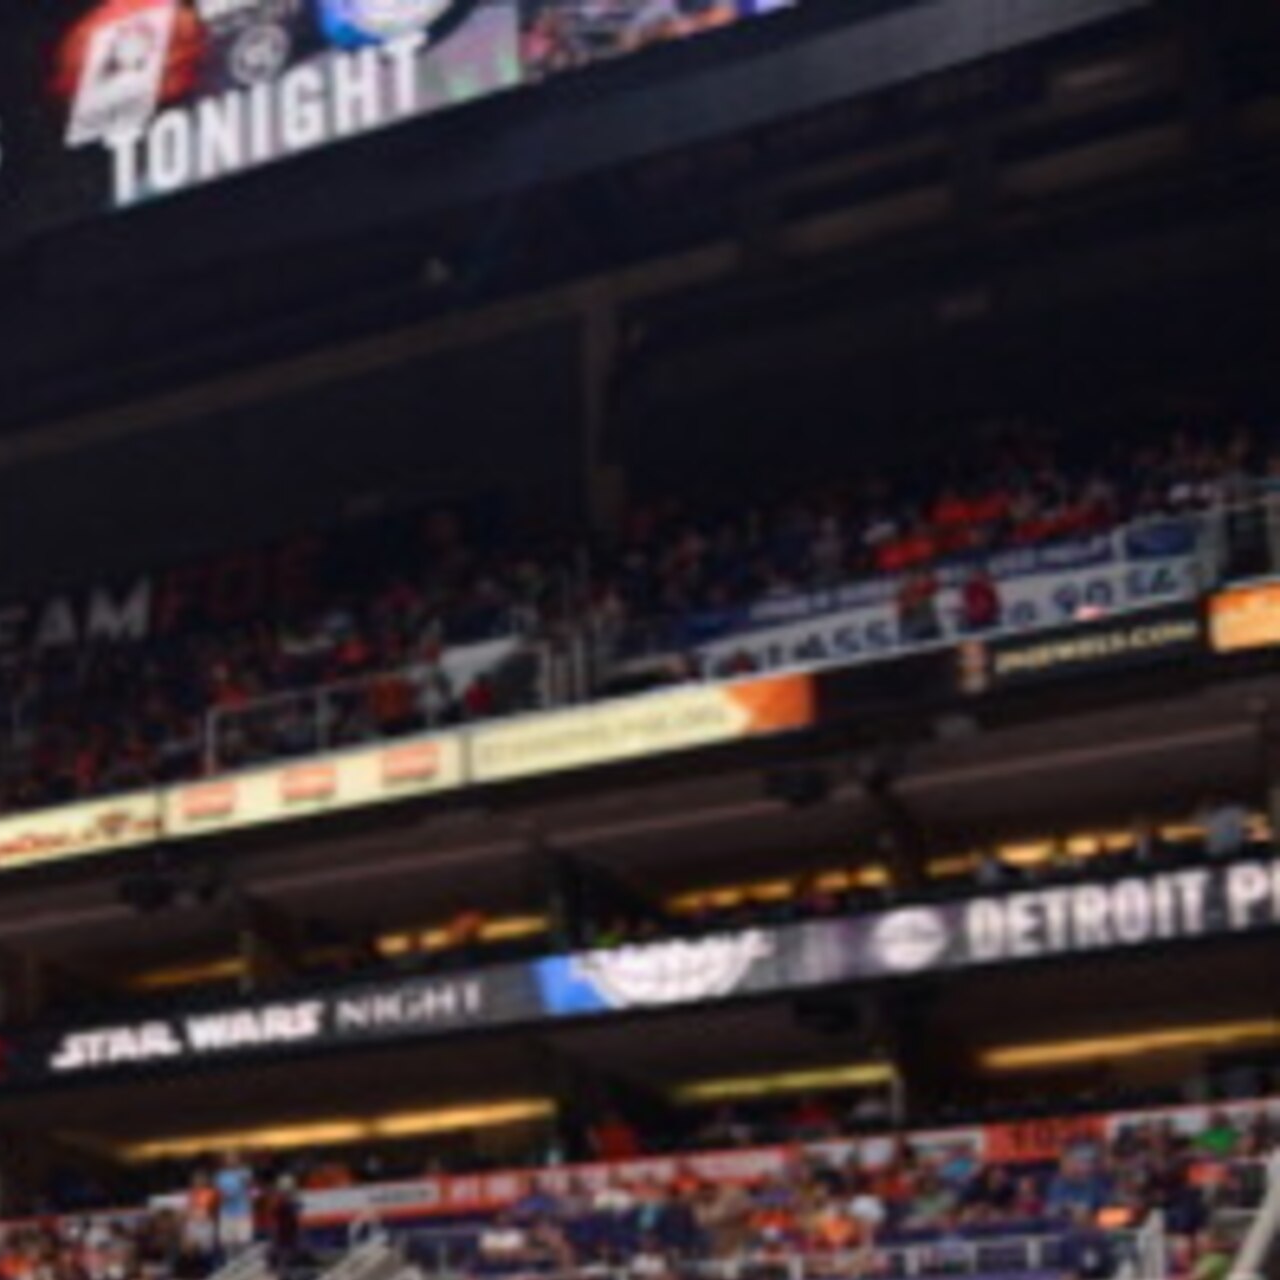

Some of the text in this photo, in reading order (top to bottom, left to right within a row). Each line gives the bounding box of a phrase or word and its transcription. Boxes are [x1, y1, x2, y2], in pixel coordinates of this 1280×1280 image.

[102, 32, 428, 208] TONIGHT
[964, 868, 1212, 961] DETROIT
[51, 978, 483, 1071] STAR WARS NIGHT
